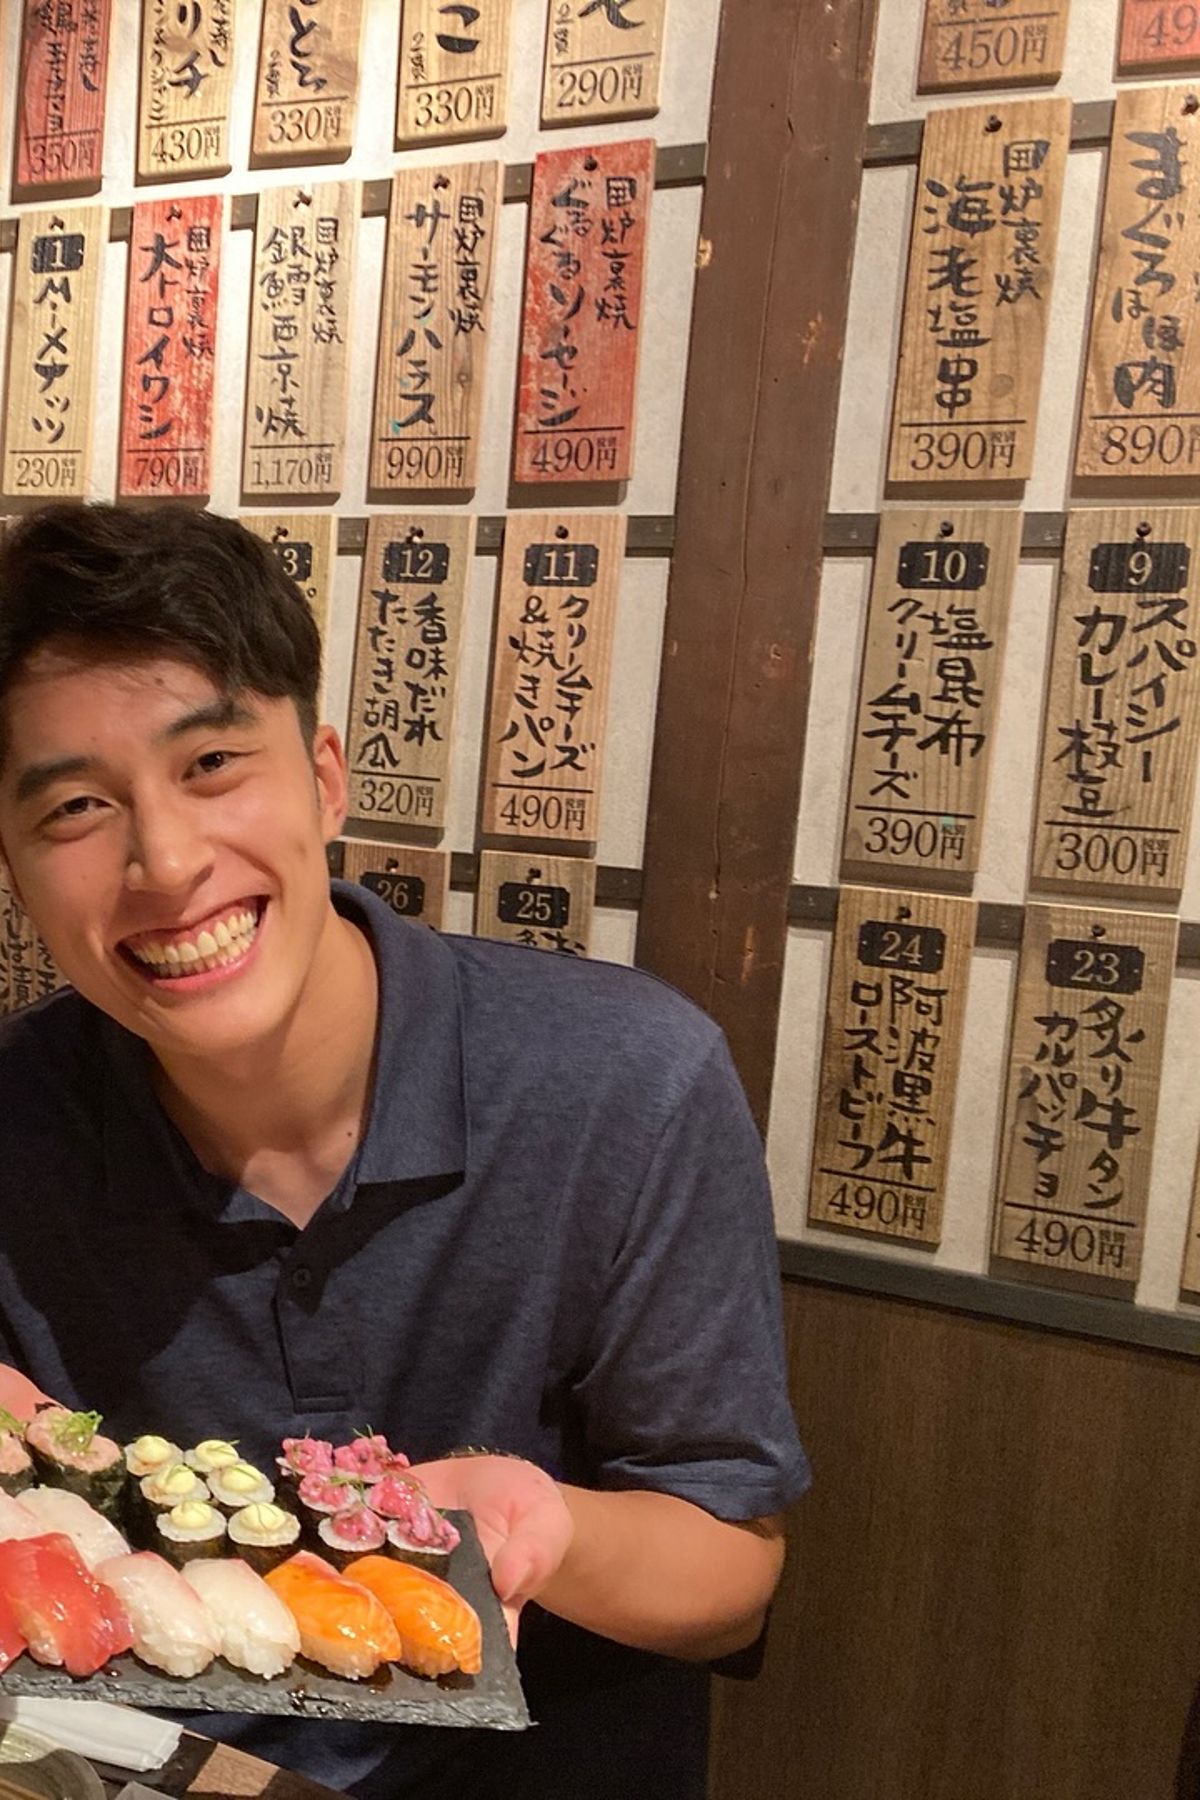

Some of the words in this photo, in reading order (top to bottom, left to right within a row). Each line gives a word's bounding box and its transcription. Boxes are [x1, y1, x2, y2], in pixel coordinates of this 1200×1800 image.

[51, 239, 65, 267] 1
[137, 233, 182, 440] 大トロイワシ
[396, 200, 451, 432] サーモンハラス
[922, 176, 996, 419] 海老塩串
[400, 549, 433, 579] 12
[544, 552, 579, 580] 11
[920, 551, 966, 583] 10
[1129, 551, 1152, 586] 9
[357, 589, 408, 770] たたき胡瓜
[403, 591, 448, 747] 香味だれ
[501, 596, 563, 779] &焼きパン
[550, 594, 596, 772] クリームチーズ
[862, 598, 924, 800] クリームチーズ
[916, 603, 994, 767] 塩昆布
[1053, 606, 1128, 818] カレー枝豆
[1125, 598, 1197, 782] スパイシー
[377, 880, 408, 909] 26
[517, 891, 552, 920] 25
[879, 931, 923, 964] 24
[1071, 950, 1121, 985] 23
[837, 979, 883, 1171] ローストビーフ
[878, 975, 948, 1180] 阿波黒牛
[1019, 1011, 1079, 1200] カルパッチョ
[1073, 996, 1146, 1210] 炙り牛タン
